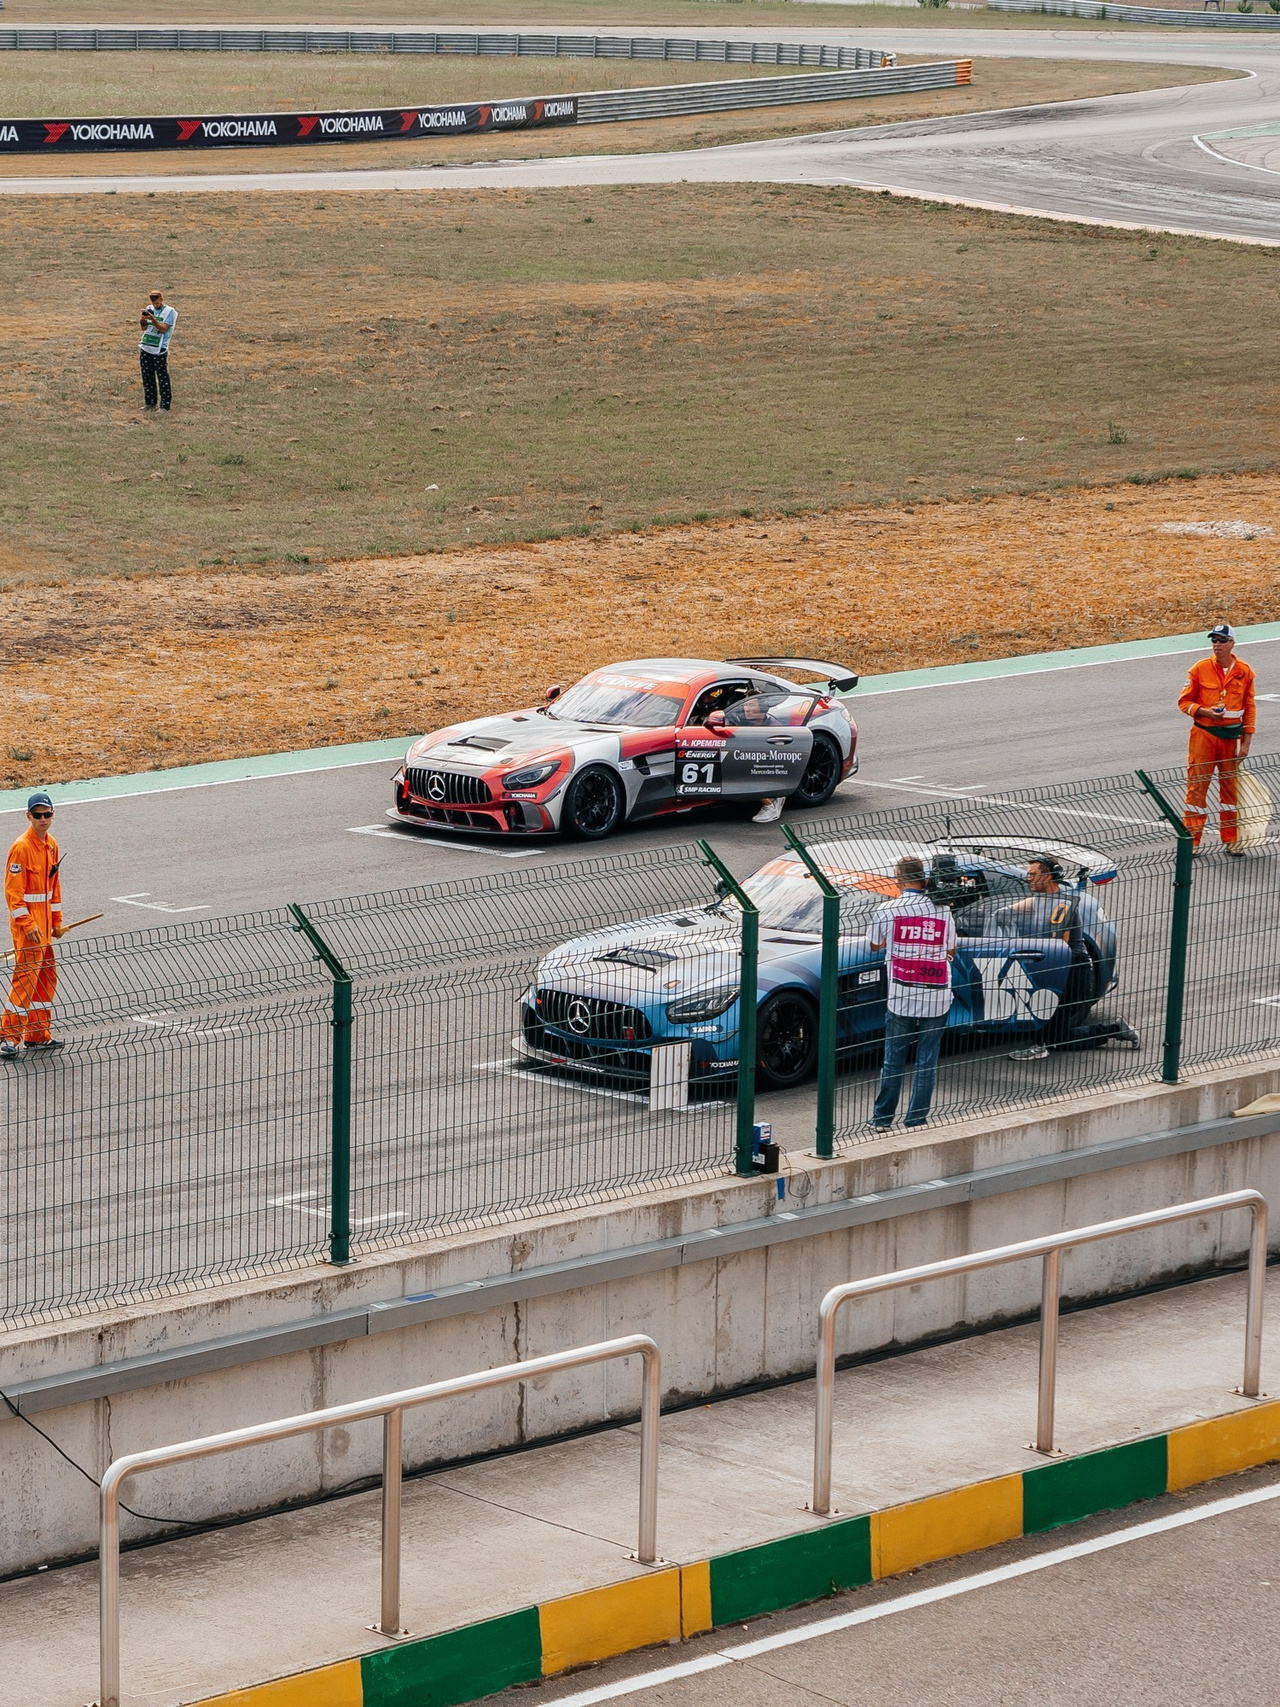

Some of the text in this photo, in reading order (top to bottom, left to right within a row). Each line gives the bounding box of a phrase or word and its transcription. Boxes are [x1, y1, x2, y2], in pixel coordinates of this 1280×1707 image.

[419, 111, 467, 128] YOKOHAMA
[491, 104, 527, 122] YOKOHAMA
[70, 124, 154, 140] YOKOHAMA
[201, 120, 277, 138] YOKOHAMA
[319, 116, 384, 133] YOKOHAMA
[733, 750, 802, 763] Самара-Моторс
[682, 763, 715, 784] 61
